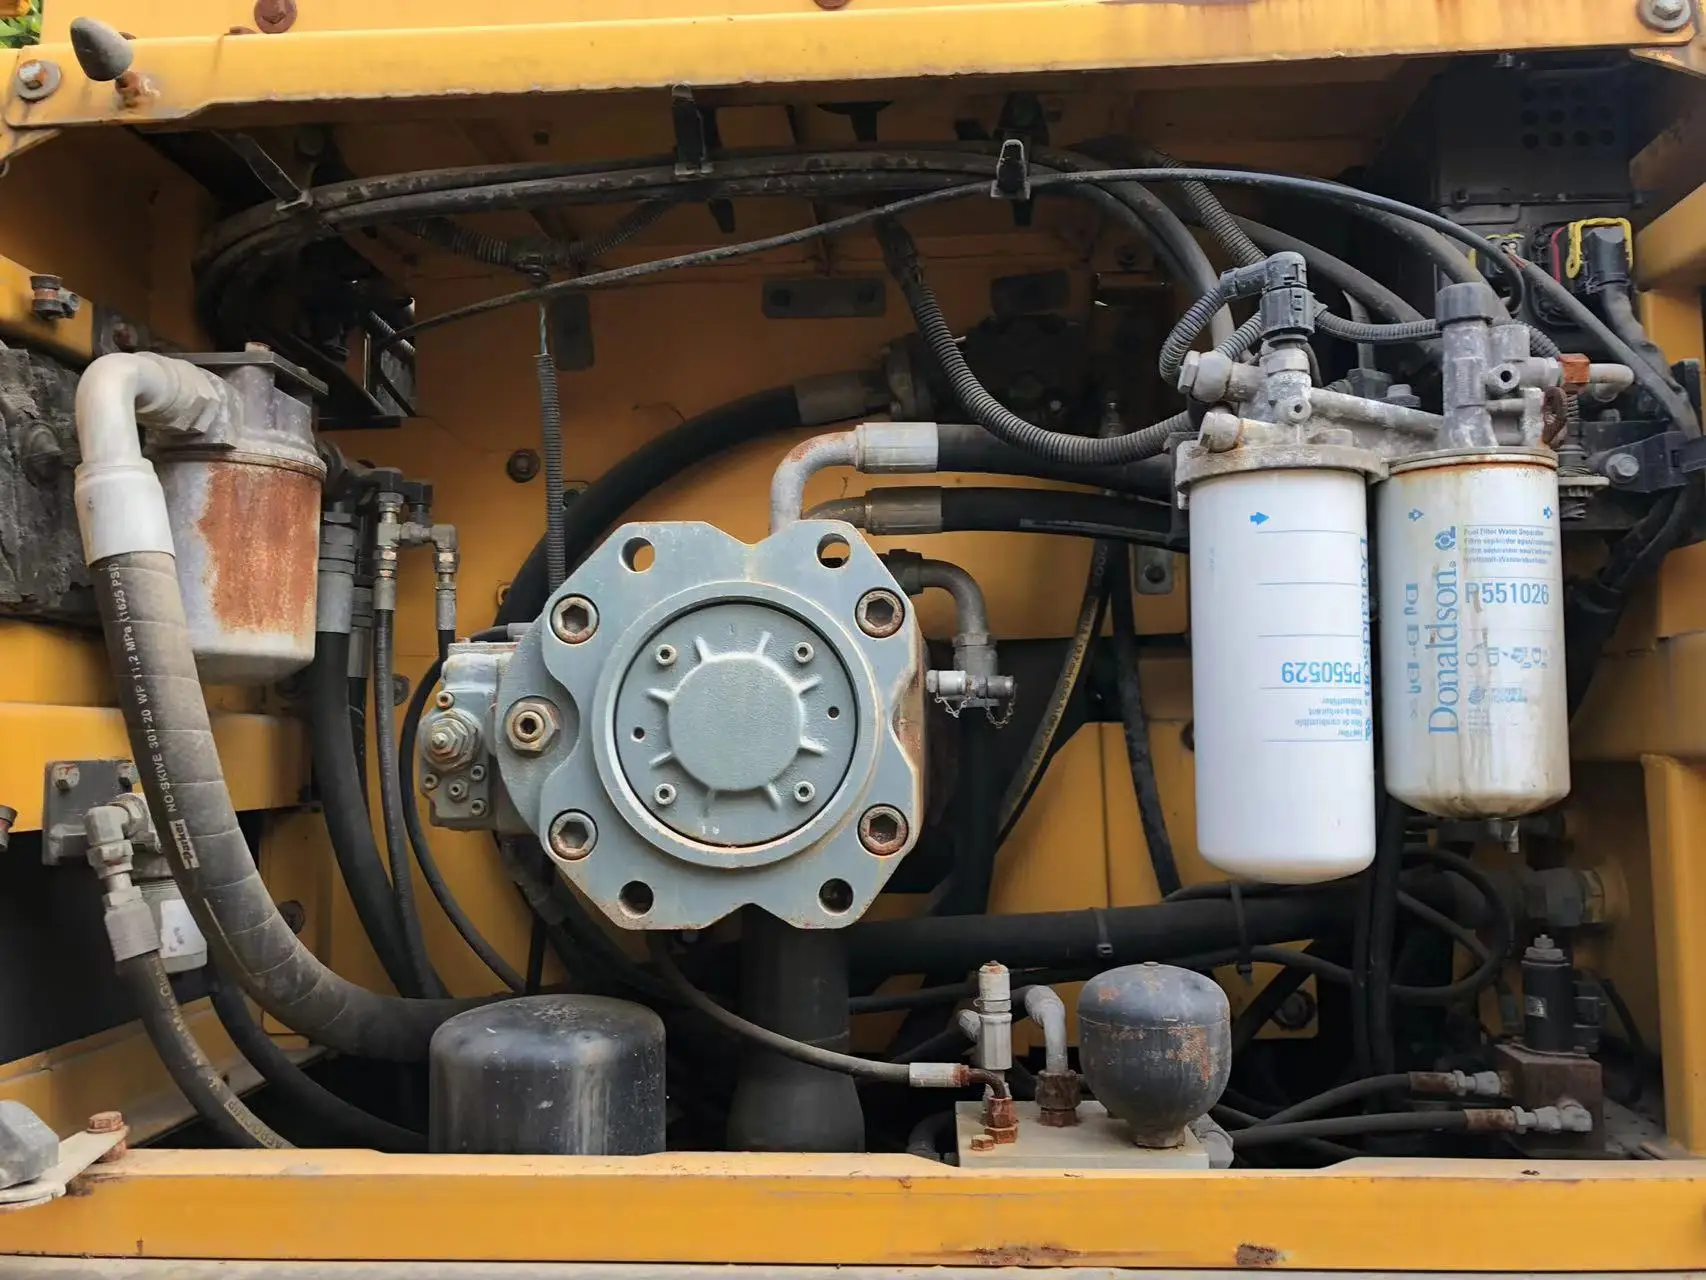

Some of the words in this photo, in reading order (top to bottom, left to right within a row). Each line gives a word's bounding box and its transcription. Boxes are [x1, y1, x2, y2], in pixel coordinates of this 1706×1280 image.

[114, 590, 131, 622] (1625
[1464, 582, 1549, 605] P551026
[123, 626, 137, 651] MPa
[128, 655, 143, 681] 11,2
[1281, 662, 1361, 684] P550529
[135, 685, 149, 705] WP
[141, 709, 159, 749] 301-20
[152, 753, 177, 812] NO-SKIVE
[173, 822, 195, 867] Parker
